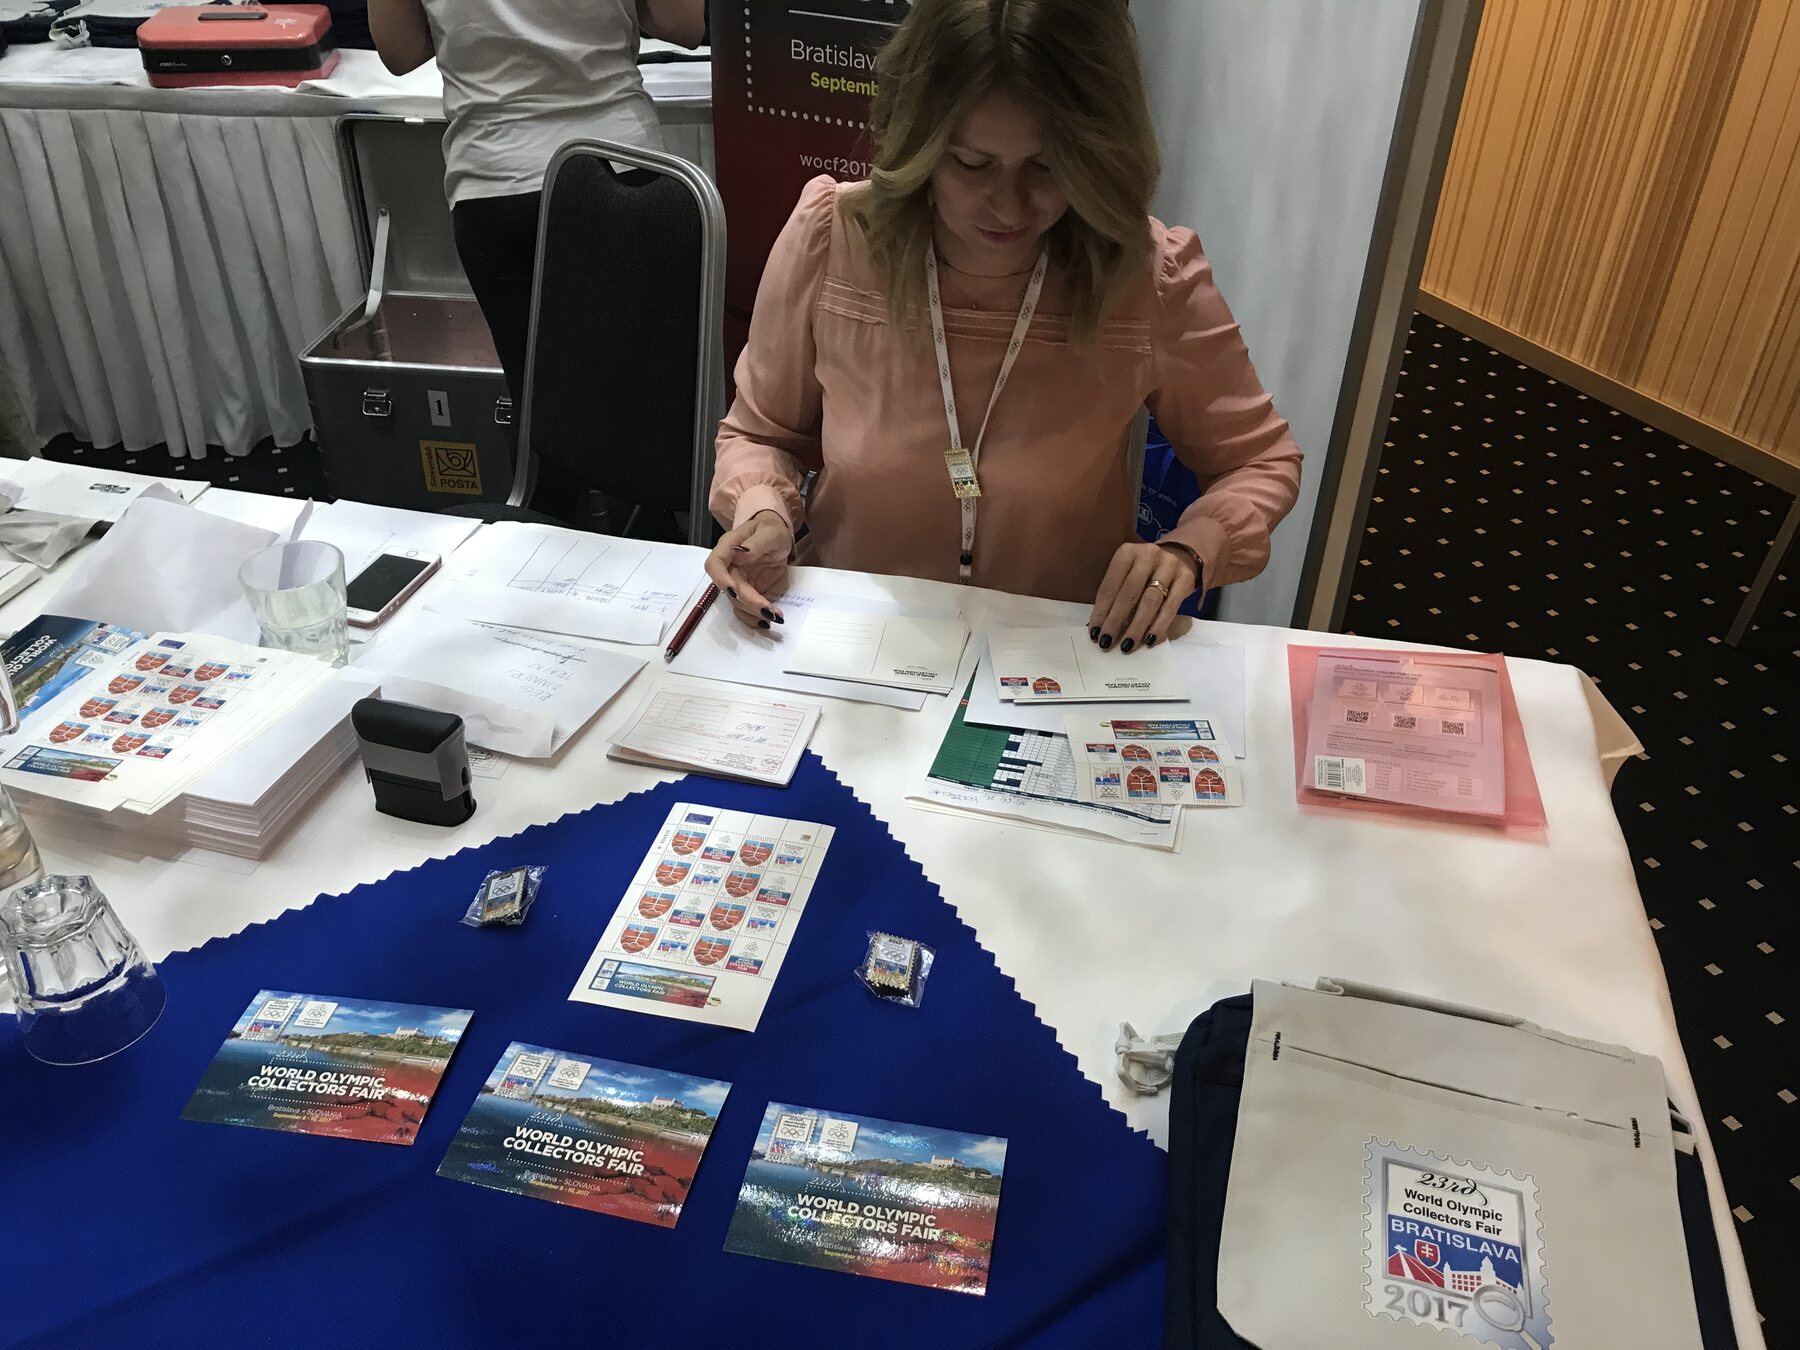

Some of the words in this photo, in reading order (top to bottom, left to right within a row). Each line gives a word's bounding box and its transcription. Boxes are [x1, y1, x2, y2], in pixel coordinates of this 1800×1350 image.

[434, 399, 445, 417] 1
[22, 638, 57, 664] WORLD
[247, 1075, 347, 1096] COLLECTORS
[349, 1086, 386, 1100] FAIR
[260, 1064, 317, 1081] WORLD
[319, 1071, 386, 1088] OLYMPIC
[497, 1088, 516, 1097] 2017
[503, 1137, 605, 1168] COLLECTORS
[606, 1159, 645, 1176] FAIR
[515, 1126, 573, 1147] WORLD
[575, 1139, 645, 1162] OLYMPIC
[768, 1153, 788, 1161] 2017
[563, 1178, 601, 1192] SLOVAKIA
[808, 1176, 846, 1193] 23rd
[1417, 1172, 1488, 1206] 23rd
[797, 1193, 860, 1214] WORLD
[863, 1205, 937, 1227] OLYMPIC
[1403, 1202, 1472, 1229] Collectors
[1475, 1221, 1502, 1236] Fair
[1404, 1188, 1443, 1208] World
[1446, 1200, 1503, 1222] Olympic
[787, 1206, 899, 1234] COLLECTORS
[901, 1224, 941, 1241] FAIR
[1391, 1218, 1519, 1264] BRATISLAVA
[1384, 1284, 1469, 1328] 2017
